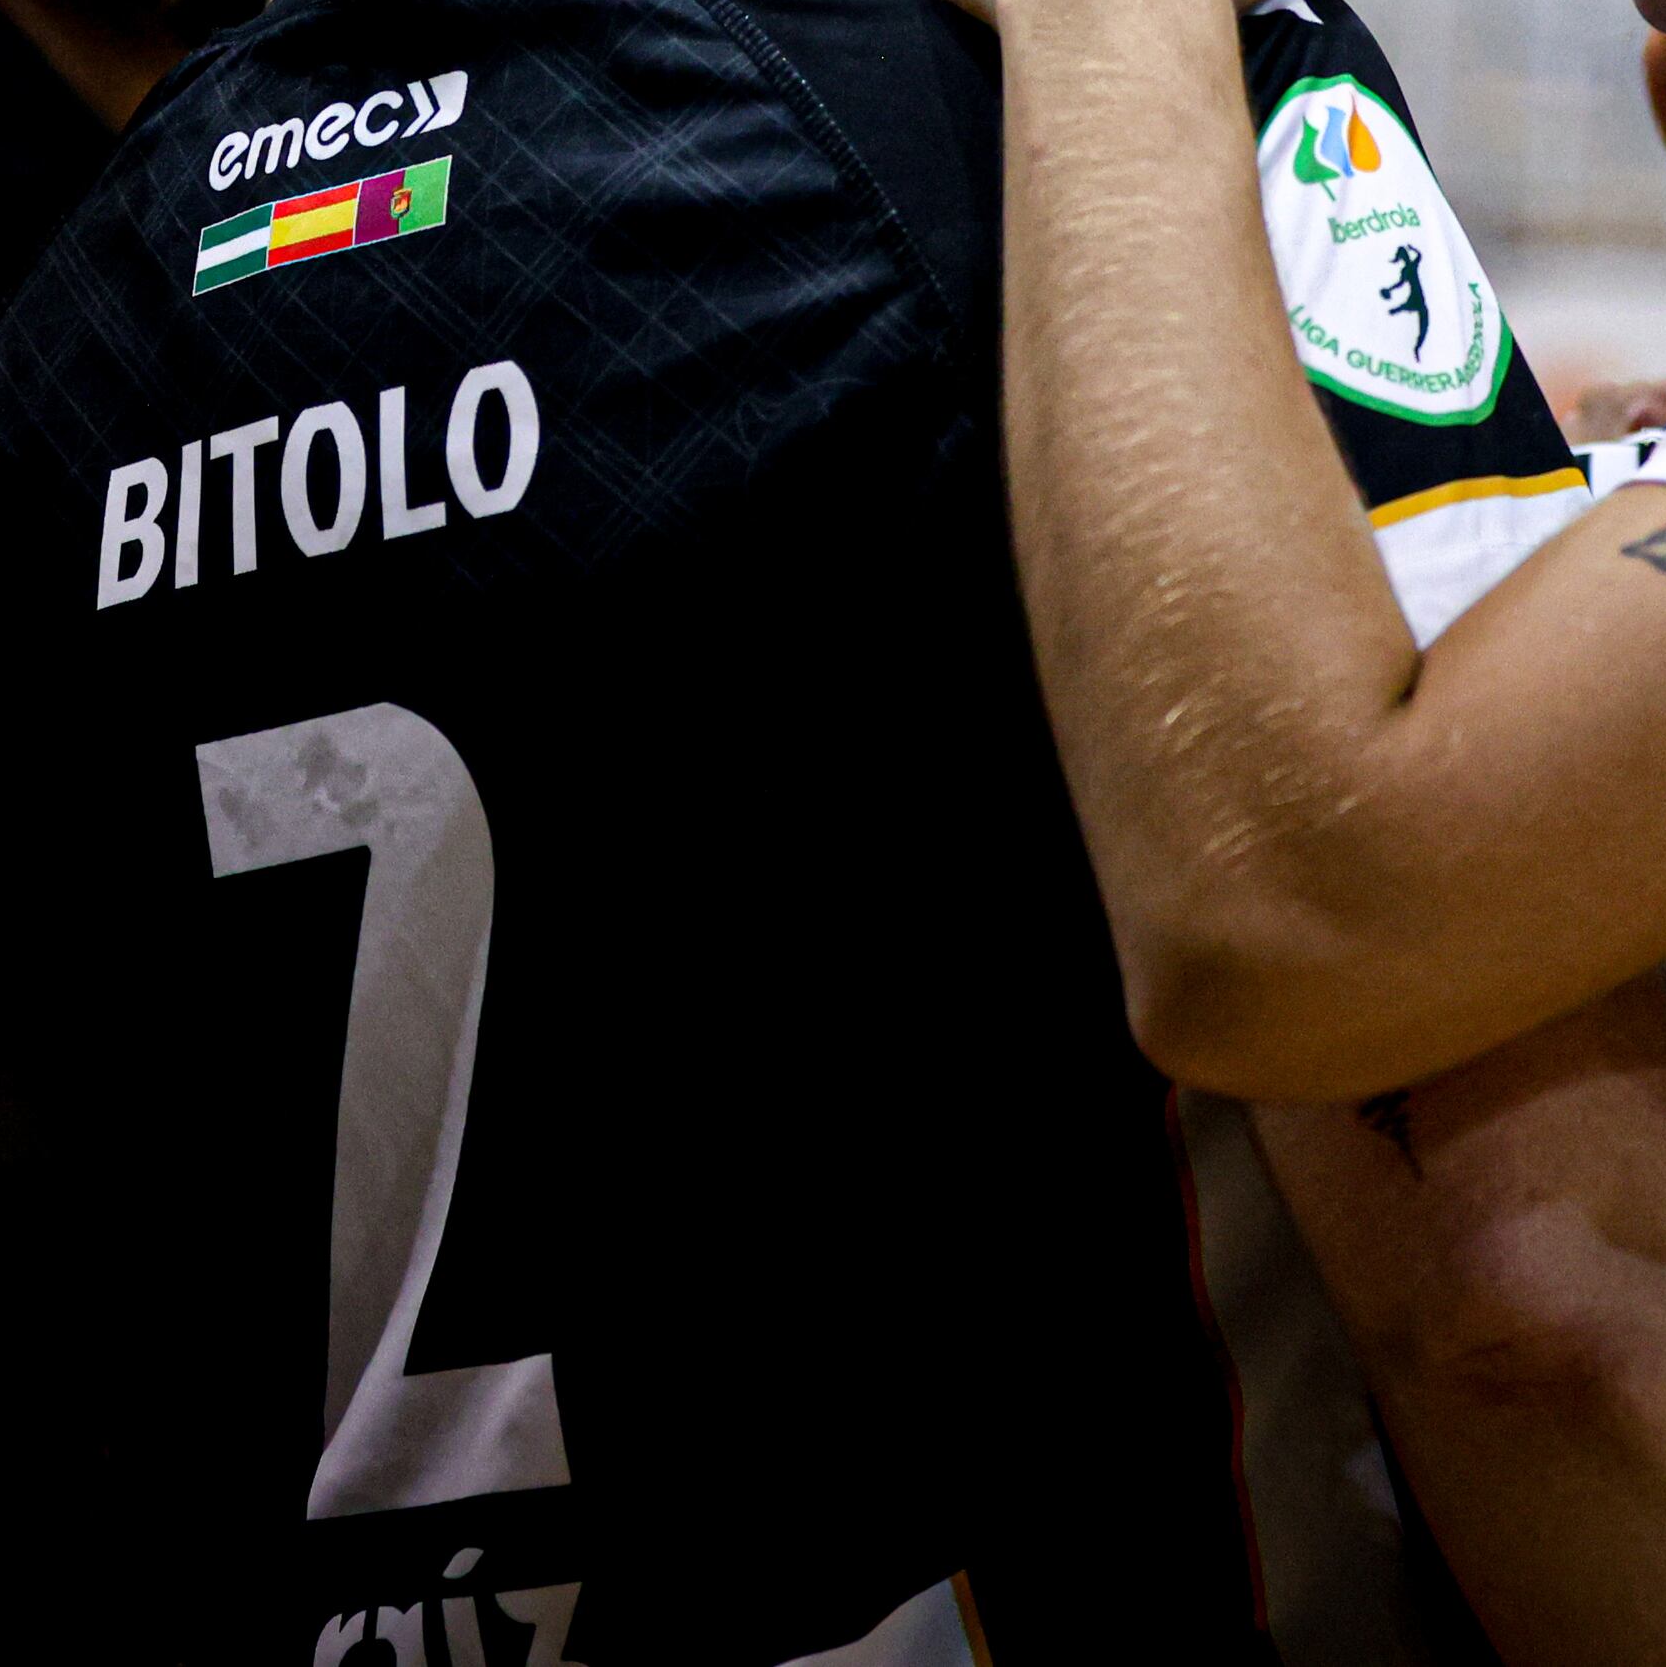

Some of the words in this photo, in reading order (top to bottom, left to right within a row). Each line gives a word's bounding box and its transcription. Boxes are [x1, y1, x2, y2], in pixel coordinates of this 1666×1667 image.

[1287, 304, 1339, 356] LIGA
[96, 359, 540, 611] BITOLO
[195, 702, 572, 1521] 2
